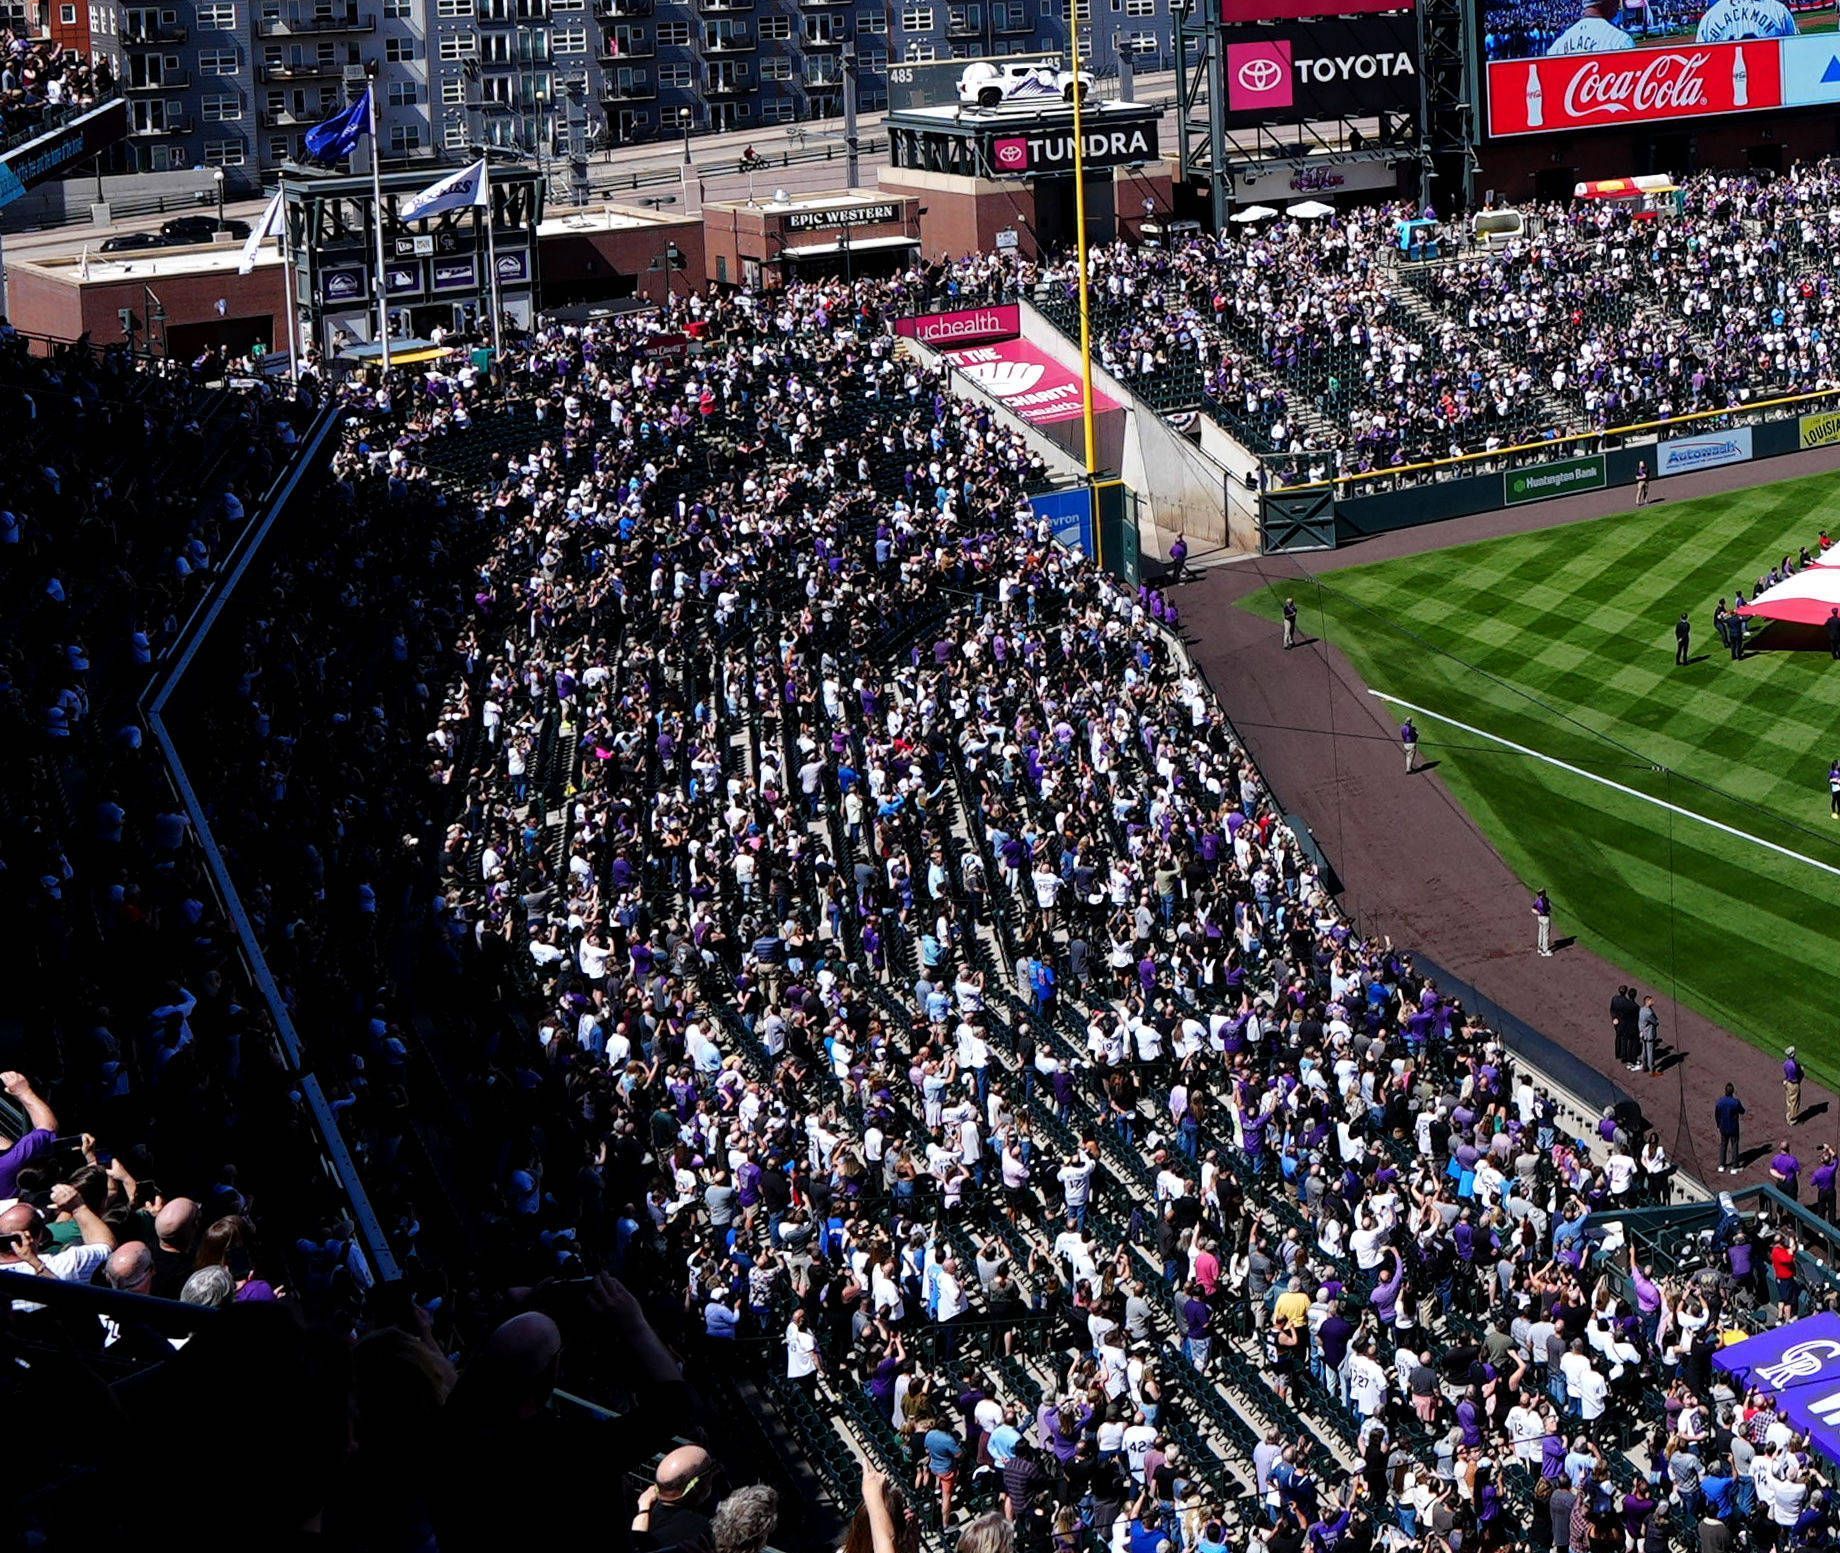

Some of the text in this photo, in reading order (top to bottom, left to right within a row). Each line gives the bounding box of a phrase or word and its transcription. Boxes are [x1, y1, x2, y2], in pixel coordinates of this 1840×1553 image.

[890, 67, 914, 84] 485
[1294, 52, 1415, 83] TOYOTA
[1563, 52, 1711, 117] Coca-Cola
[1028, 130, 1148, 163] TUNDRA
[790, 212, 823, 228] EPIC
[826, 205, 893, 223] WESTERN
[916, 312, 1000, 339] uchealth
[1669, 442, 1737, 465] Autowash
[1526, 467, 1598, 490] Huntington Bank
